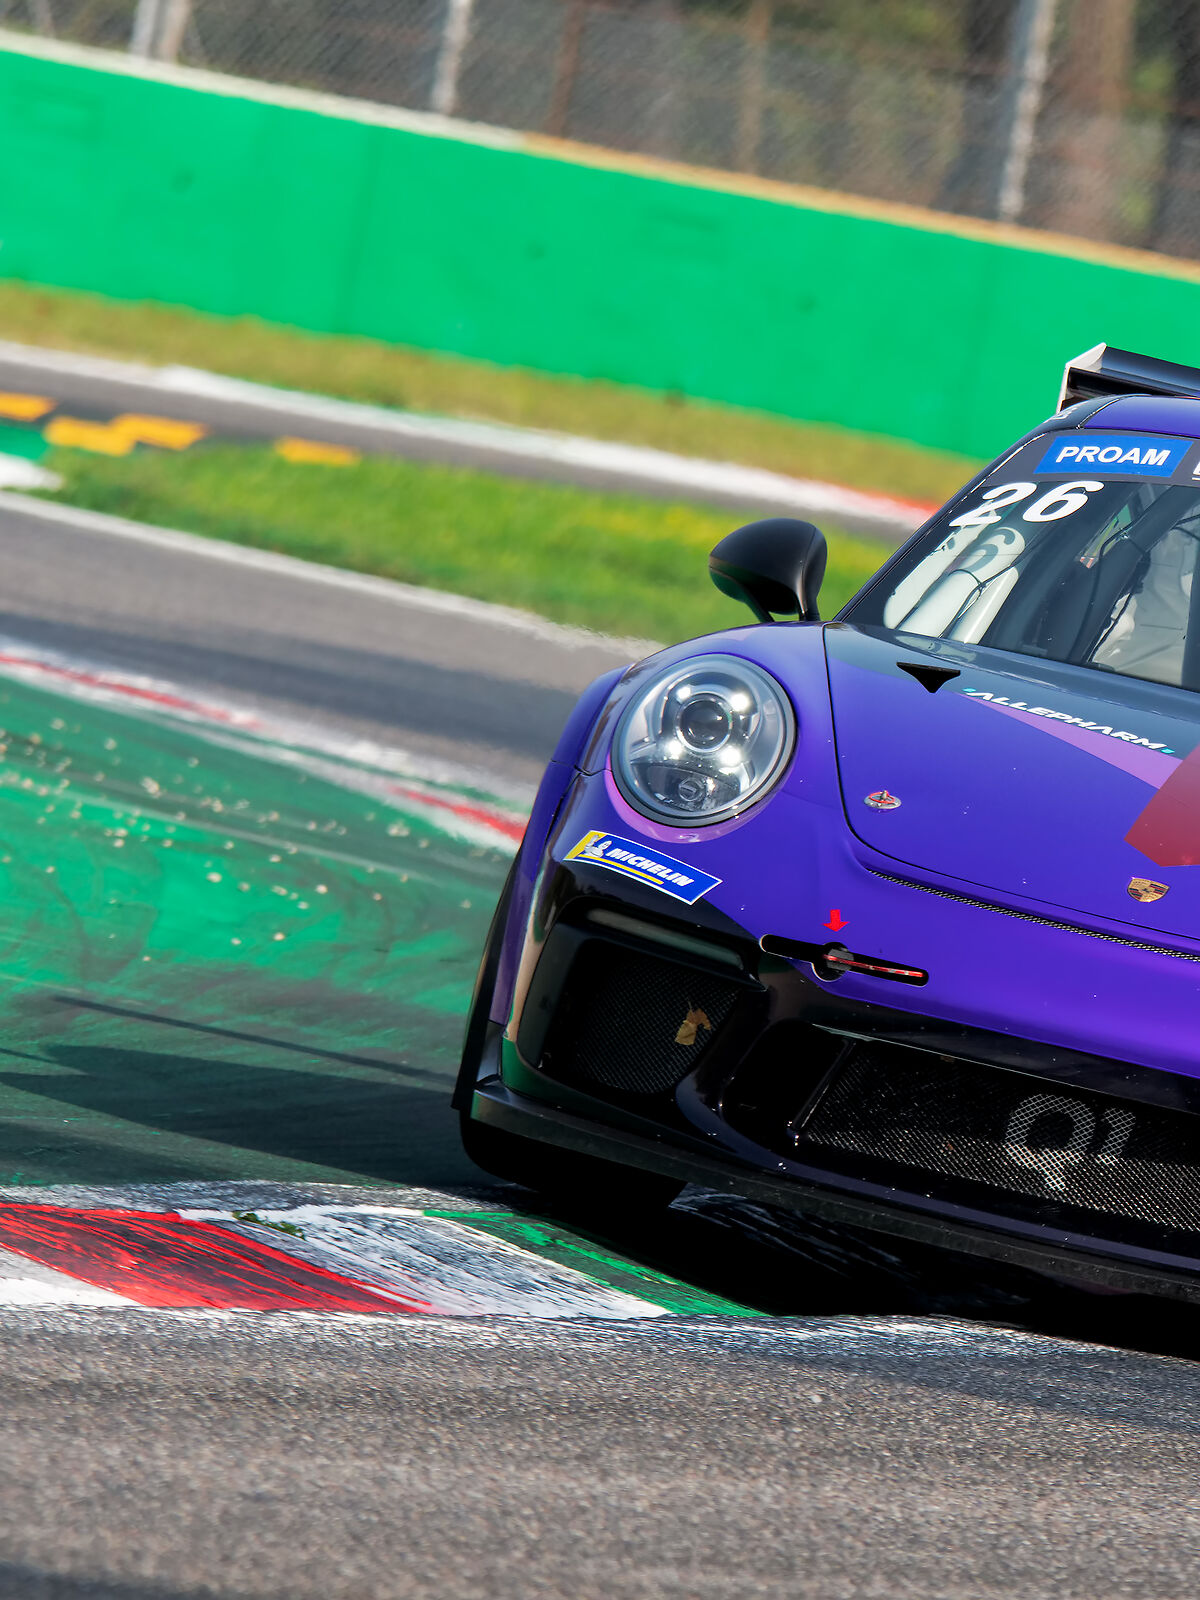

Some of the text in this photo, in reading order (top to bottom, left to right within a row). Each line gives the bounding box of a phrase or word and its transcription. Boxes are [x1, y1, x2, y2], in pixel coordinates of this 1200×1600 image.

[1055, 445, 1172, 467] PROAM
[949, 480, 1105, 528] 26
[966, 692, 1168, 750] ALLEPHARM
[605, 847, 695, 887] MICHELIN
